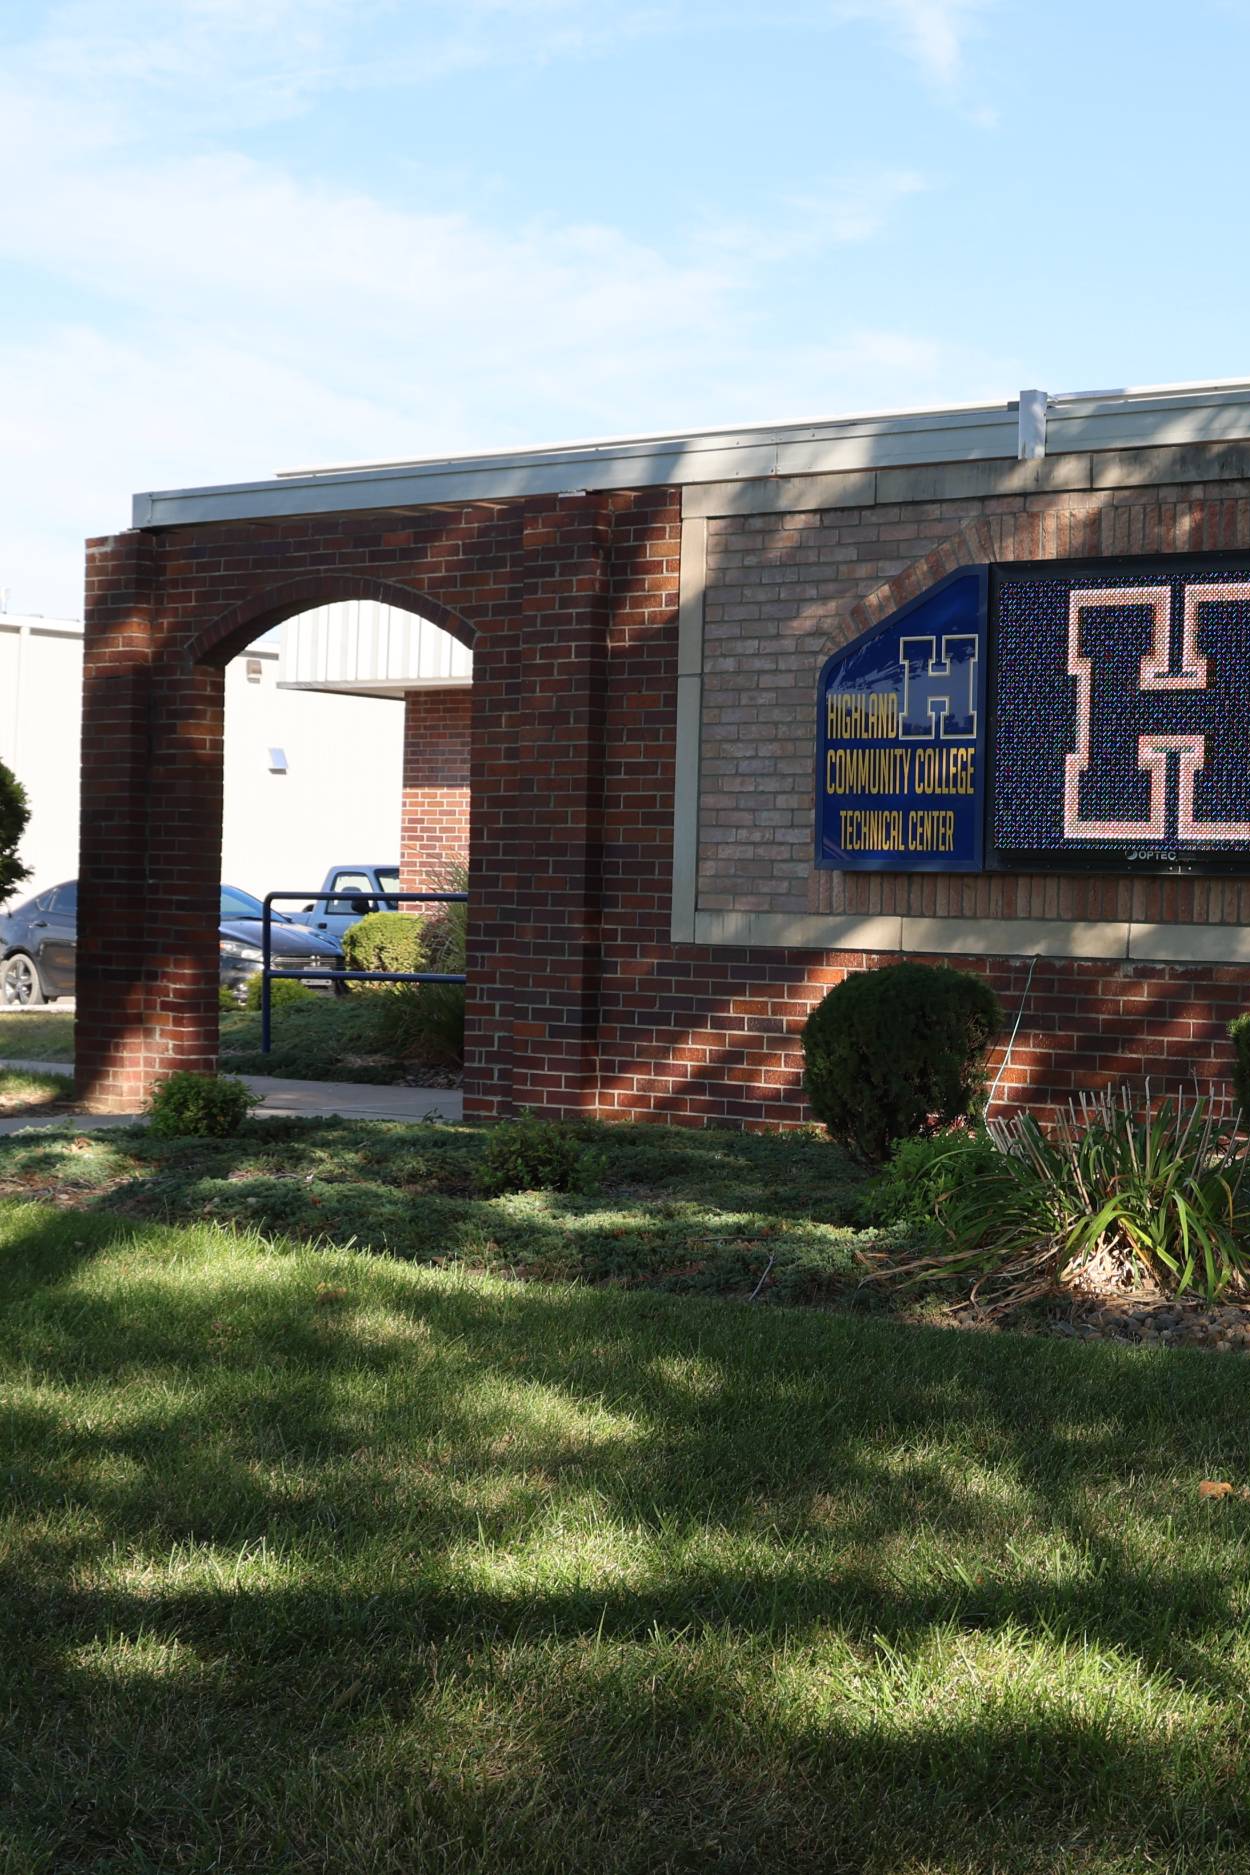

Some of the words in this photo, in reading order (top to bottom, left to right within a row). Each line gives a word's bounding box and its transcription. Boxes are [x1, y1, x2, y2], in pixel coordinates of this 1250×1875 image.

[898, 634, 979, 741] H
[827, 692, 897, 740] HIGHLAND
[826, 748, 911, 795] COMMUNITY
[914, 747, 977, 795] COLLEGE
[839, 810, 905, 851] TECHNICAL
[908, 810, 955, 852] CENTER
[1138, 850, 1177, 861] OPTEC
